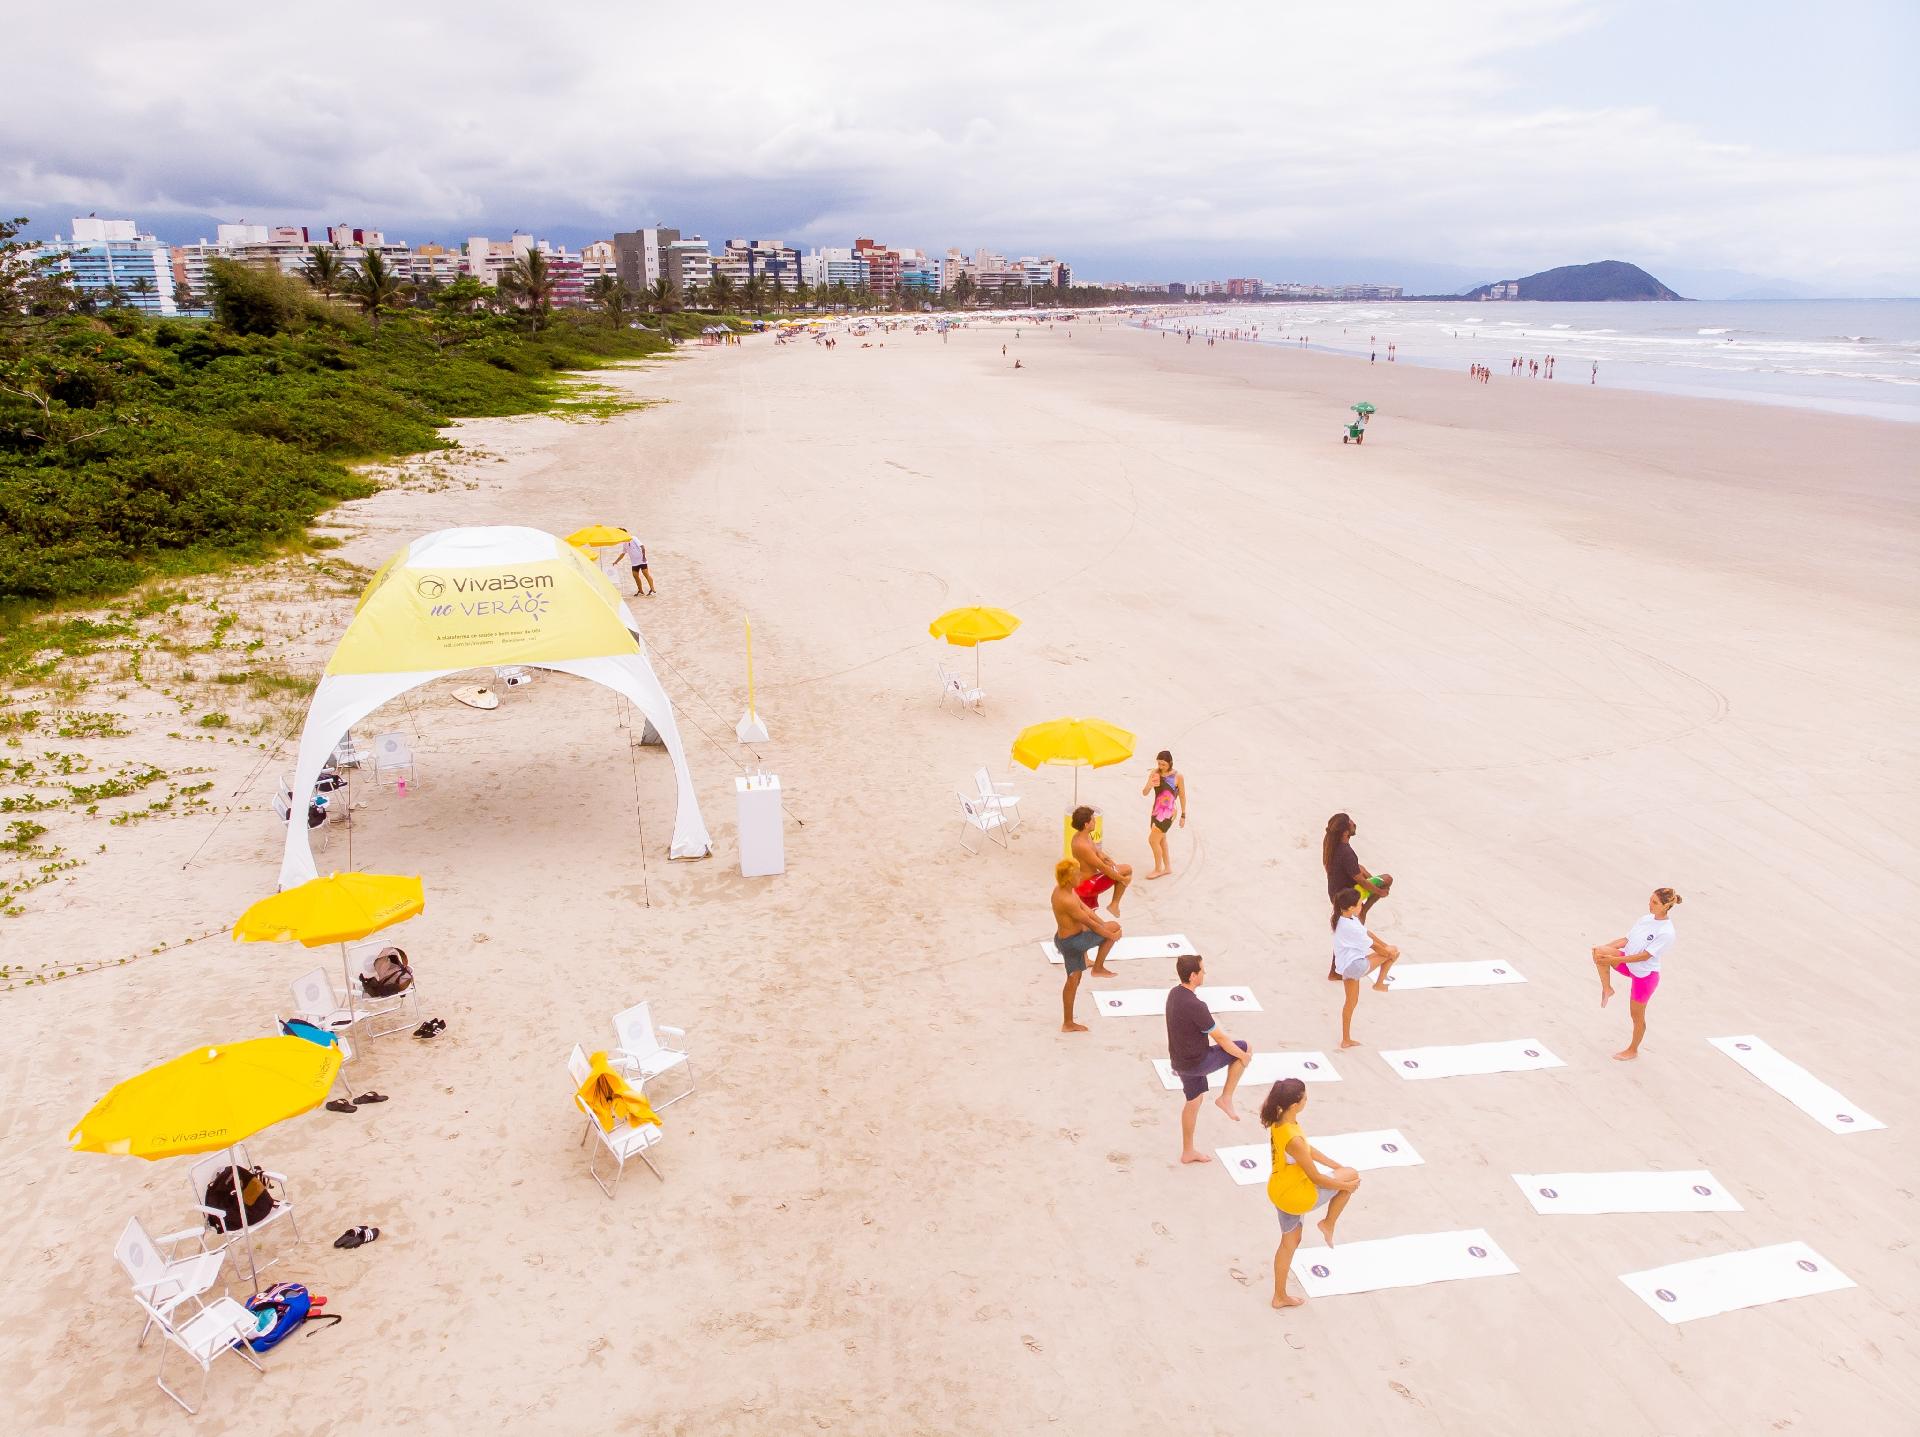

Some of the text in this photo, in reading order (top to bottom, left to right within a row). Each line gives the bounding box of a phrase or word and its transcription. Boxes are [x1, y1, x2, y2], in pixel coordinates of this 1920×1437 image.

[453, 574, 553, 592] VivaBem
[431, 594, 539, 616] no VERÃO
